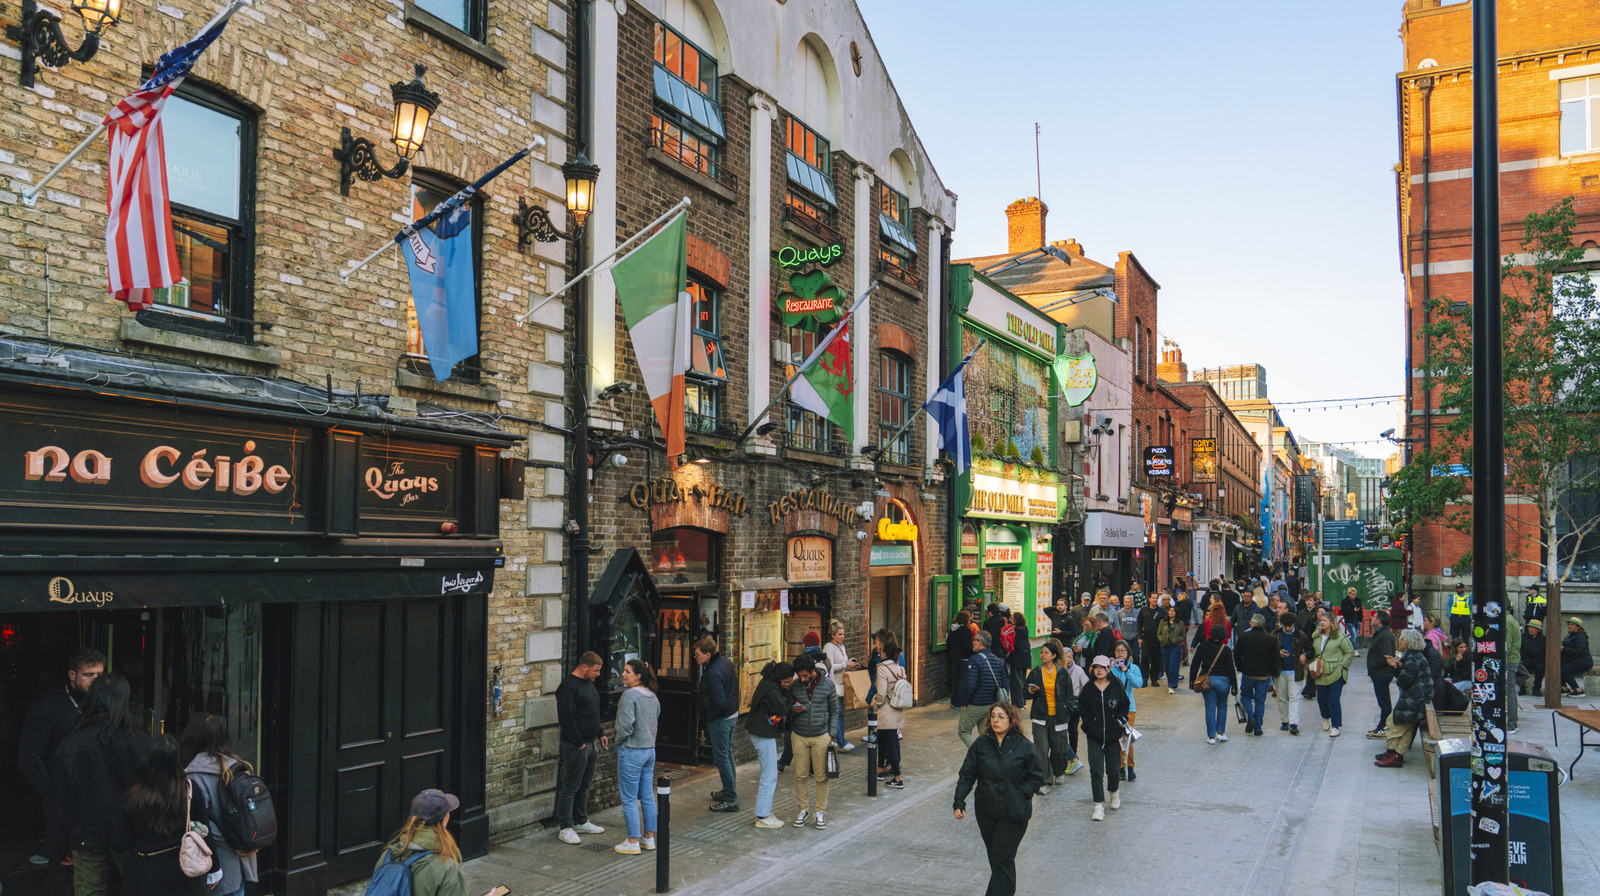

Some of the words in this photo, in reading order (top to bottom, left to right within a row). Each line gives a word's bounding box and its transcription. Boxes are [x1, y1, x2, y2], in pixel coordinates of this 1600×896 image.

[778, 244, 842, 268] Quays
[1006, 312, 1023, 338] THE
[1023, 321, 1039, 345] OLD
[1039, 330, 1056, 355] MILL
[1066, 365, 1095, 379] OLD
[1065, 379, 1094, 390] MILL
[1193, 439, 1216, 448] RORY'S
[387, 461, 406, 477] The
[1146, 458, 1173, 466] BURGERS
[364, 466, 439, 500] Quays
[399, 492, 421, 507] Bar
[987, 491, 1006, 512] OLD
[1006, 493, 1026, 514] MILL
[793, 538, 826, 566] Quays
[998, 549, 1010, 561] TAKE
[1010, 549, 1020, 560] OUT
[47, 576, 114, 608] Quays
[1508, 854, 1527, 865] BLIN
